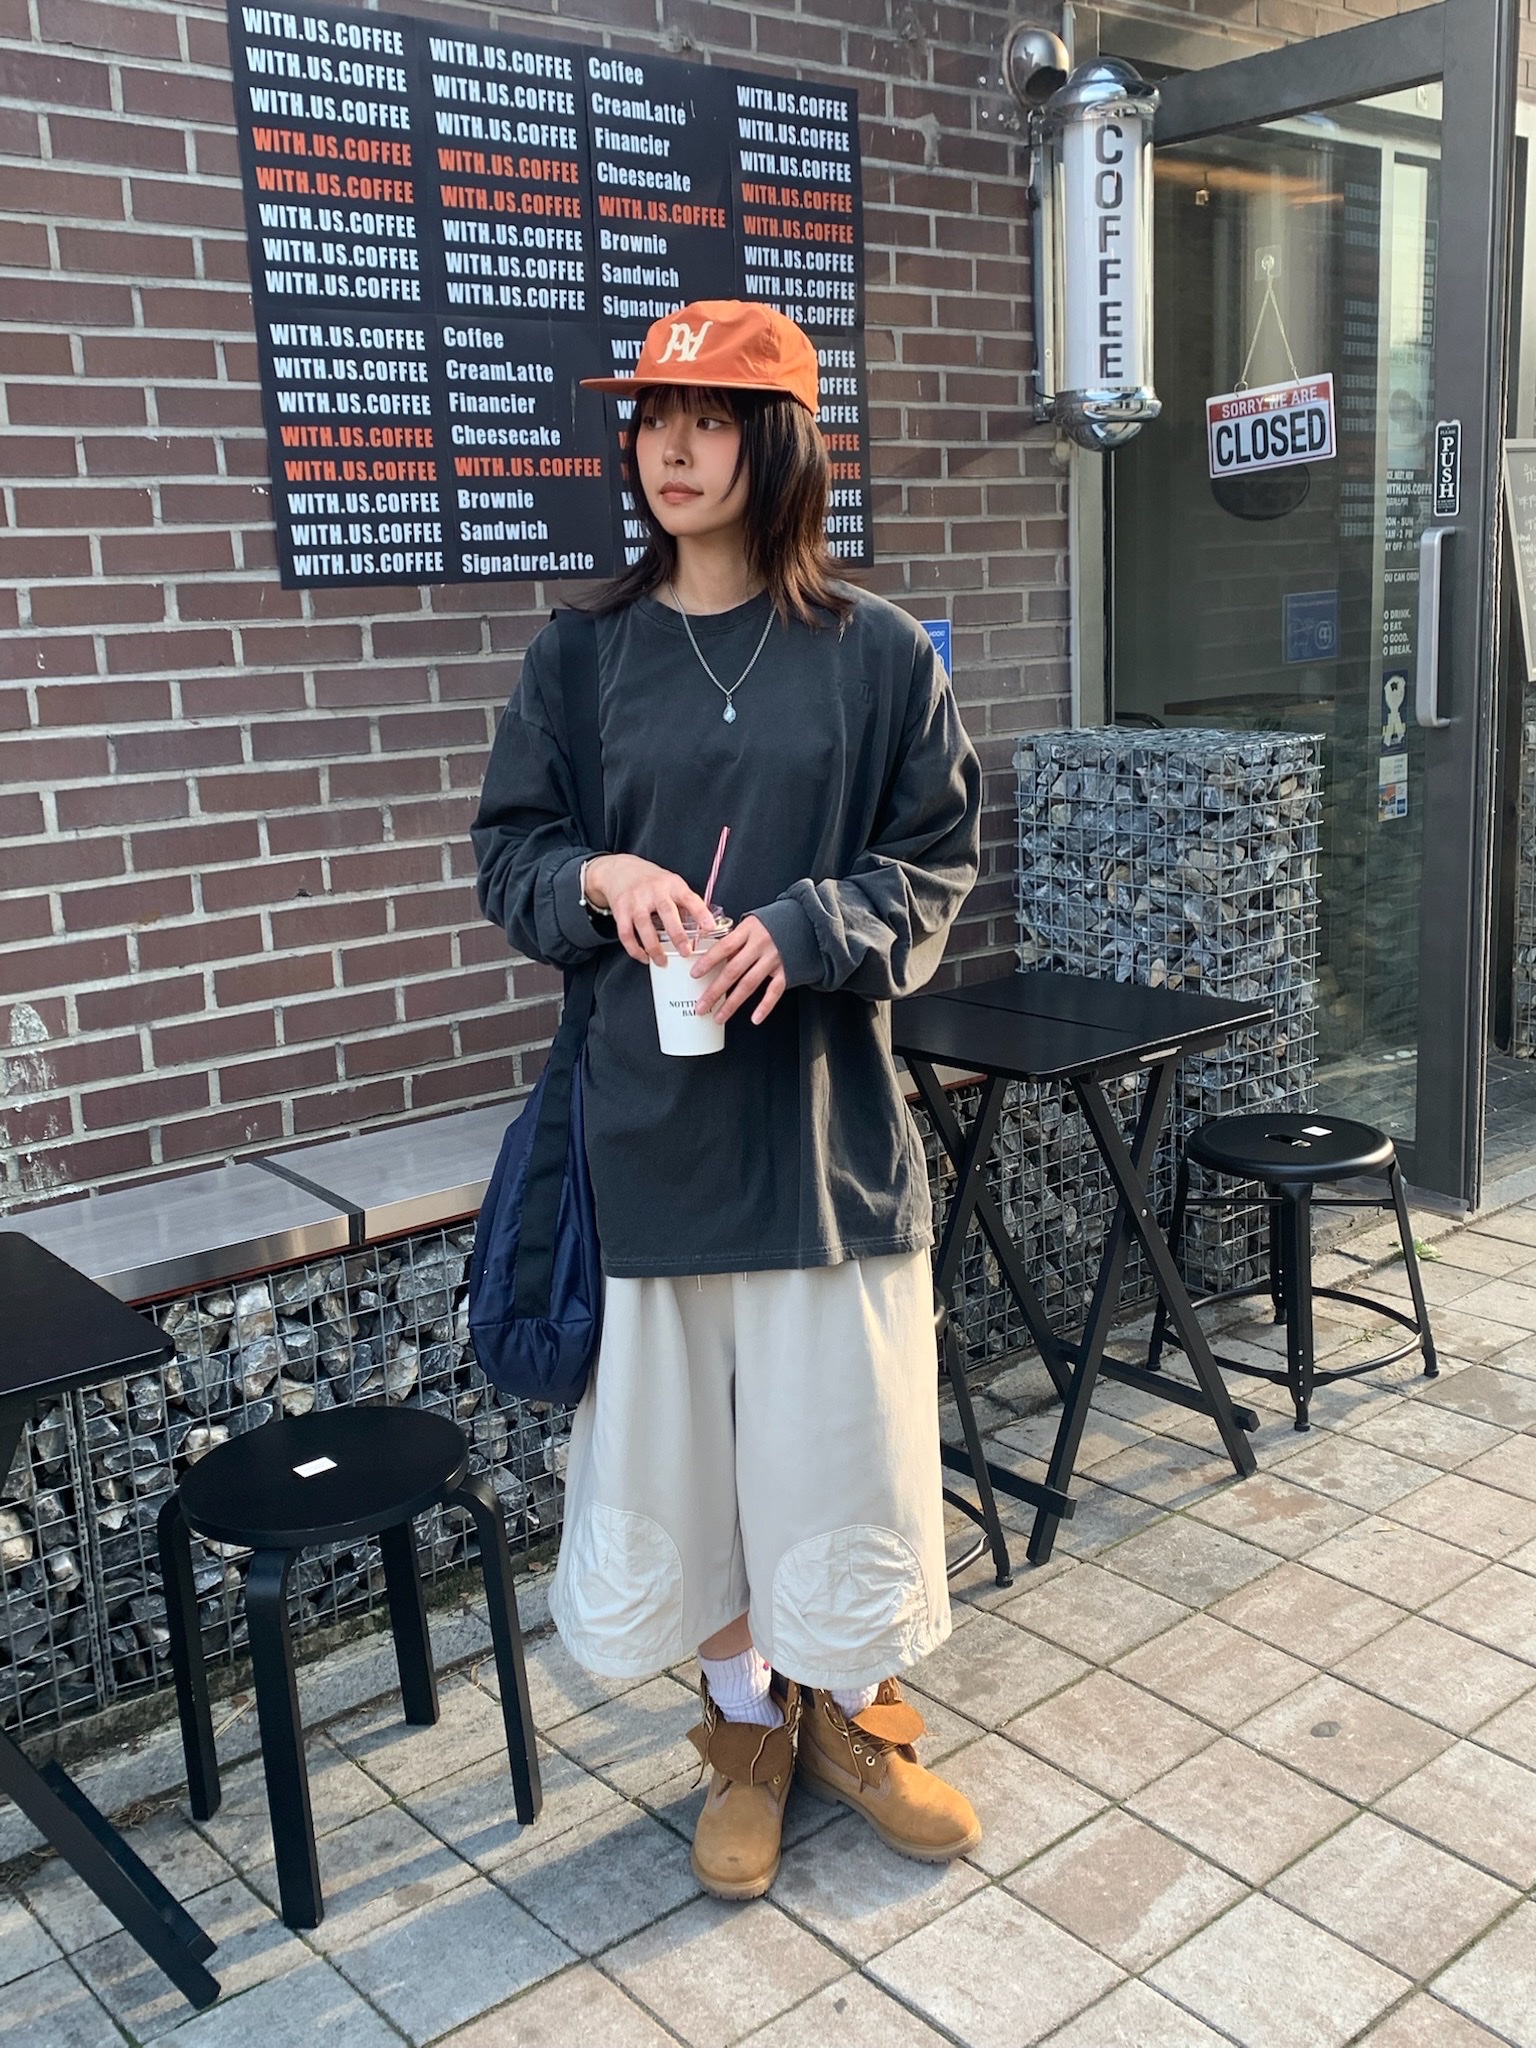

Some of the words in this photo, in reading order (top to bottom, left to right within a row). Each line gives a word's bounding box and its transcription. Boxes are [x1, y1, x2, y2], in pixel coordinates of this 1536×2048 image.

[242, 7, 404, 56] WITH.US.COFFEE
[246, 47, 407, 92] WITH.US.COFFEE
[429, 38, 572, 81] WITH.US.COFFEE
[589, 57, 643, 85] Coffee
[250, 87, 410, 129] WITH.US.COFFEE
[432, 74, 575, 115] WITH.US.COFFEE
[737, 86, 847, 121] WITH.US.COFFEE
[592, 93, 686, 125] CreamLatte
[435, 111, 577, 149] WITH.US.COFFEE
[595, 127, 669, 156] Financier
[738, 118, 849, 151] WITH.US.COFFEE
[253, 128, 412, 166] WITH.US.COFFEE
[439, 149, 579, 183] WITH.US.COFFEE
[597, 162, 690, 192] Cheesecake
[740, 150, 851, 182] WITH.US.COFFEE
[256, 167, 414, 203] WITH.US.COFFEE
[742, 183, 853, 212] WITH.US.COFFEE
[442, 186, 581, 218] WITH.US.COFFEE
[600, 196, 726, 228] WITH.US.COFFEE
[259, 204, 416, 238] WITH.US.COFFEE
[744, 216, 854, 243] WITH.US.COFFEE
[443, 220, 582, 251] WITH.US.COFFEE
[601, 230, 666, 254] Brownie
[263, 238, 419, 270] WITH.US.COFFEE
[744, 246, 854, 273] WITH.US.COFFEE
[1095, 124, 1124, 379] COFFEE
[445, 252, 584, 281] WITH.US.COFFEE
[602, 263, 679, 287] Sandwich
[265, 270, 420, 301] WITH.US.COFFEE
[447, 282, 585, 310] WITH.US.COFFEE
[745, 275, 855, 300] WITH.US.COFFEE
[270, 324, 425, 350] WITH.US.COFFEE
[444, 327, 503, 348] Coffee
[273, 357, 428, 382] WITH.US.COFFEE
[446, 360, 553, 382] CreamLatte
[277, 392, 431, 415] WITH.US.COFFEE
[449, 392, 535, 413] Financier
[1221, 397, 1265, 419] SORRY
[1265, 391, 1288, 411] WE
[1291, 386, 1318, 406] ARE
[281, 426, 434, 448] WITH.US.COFFEE
[452, 425, 560, 445] Cheesecake
[1216, 407, 1326, 466] CLOSED
[285, 461, 437, 481] WITH.US.COFFEE
[455, 457, 602, 477] WITH.US.COFFEE
[1438, 436, 1456, 498] PUSH
[288, 493, 439, 514] WITH.US.COFFEE
[458, 489, 533, 508] Brownie
[291, 523, 442, 545] WITH.US.COFFEE
[461, 521, 547, 541] Sandwich
[1392, 542, 1403, 551] OFF
[293, 552, 443, 575] WITH.US.COFFEE
[462, 552, 593, 575] SignatureLatte
[1384, 572, 1393, 583] OU
[1393, 572, 1406, 582] CAN
[1383, 610, 1389, 620] O
[1390, 608, 1411, 619] DRINK.
[1383, 622, 1389, 632] O
[1389, 620, 1403, 631] EAT.
[1382, 634, 1389, 644] O
[1389, 632, 1409, 643] GOOD.
[1382, 646, 1389, 656] O
[1389, 644, 1412, 656] BREAK.
[669, 1000, 698, 1008] NOTTI
